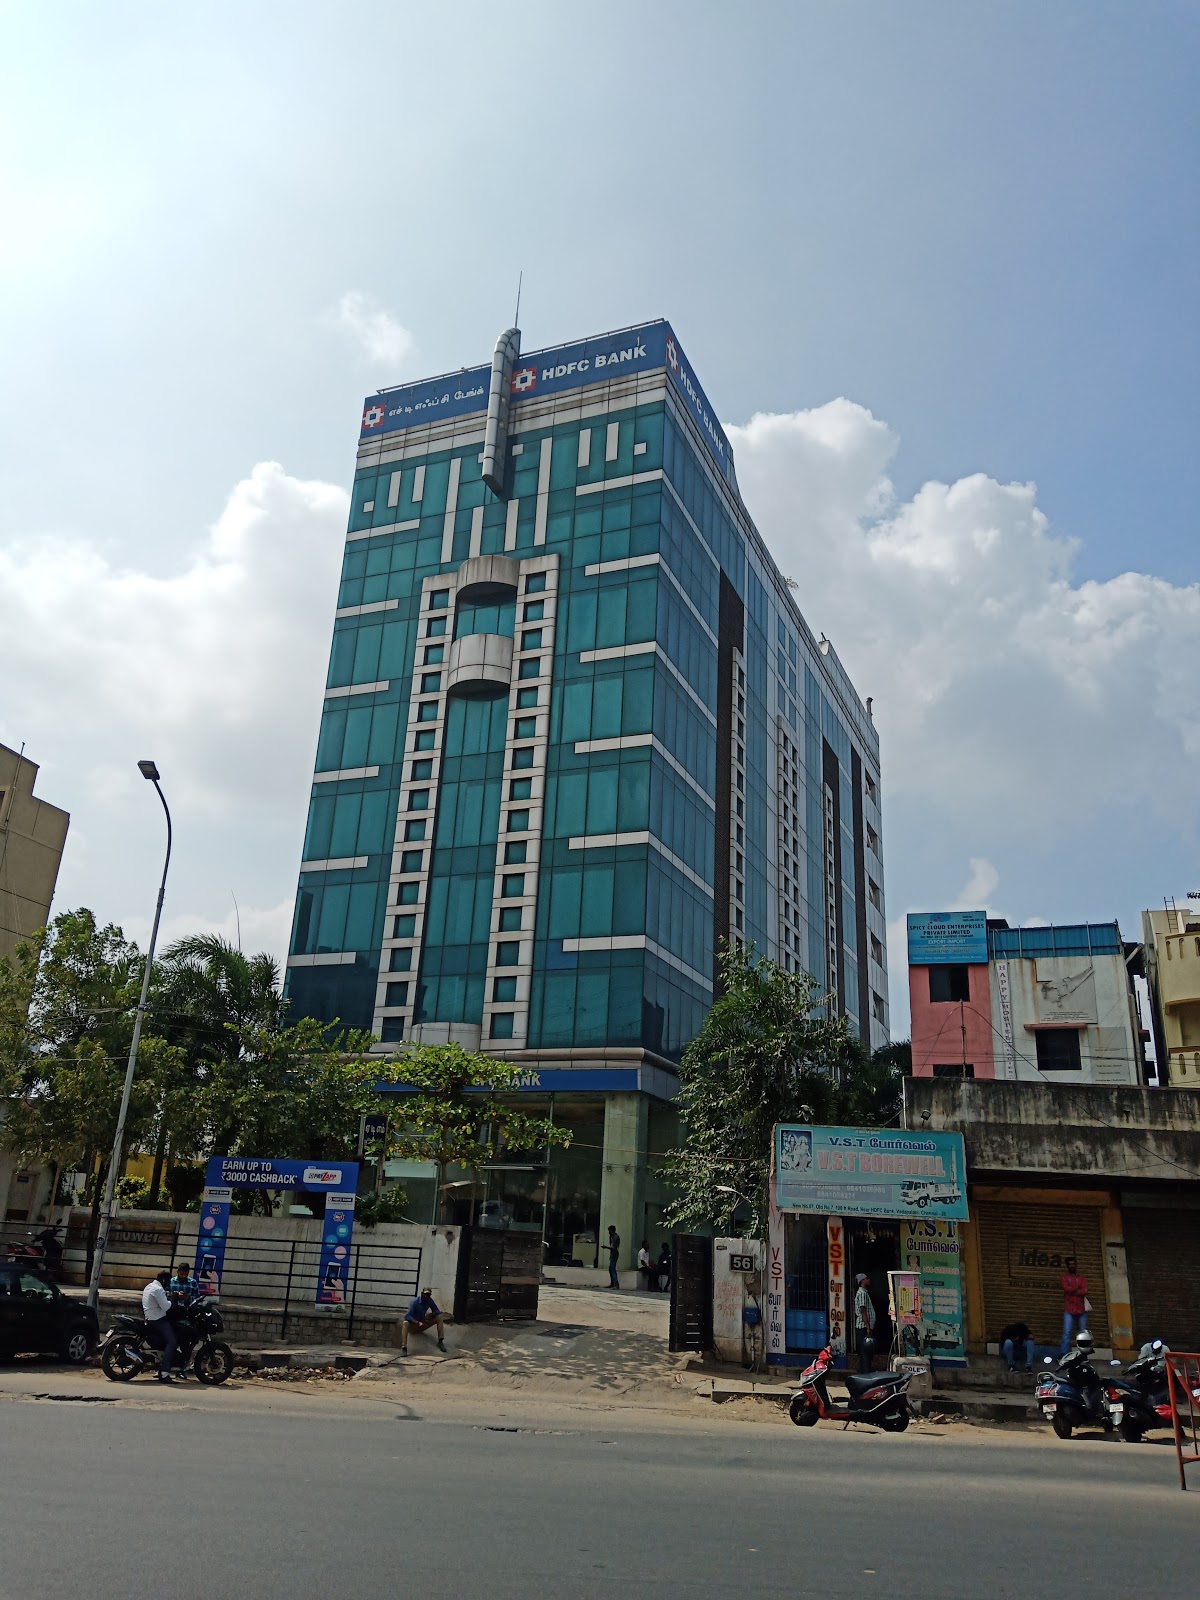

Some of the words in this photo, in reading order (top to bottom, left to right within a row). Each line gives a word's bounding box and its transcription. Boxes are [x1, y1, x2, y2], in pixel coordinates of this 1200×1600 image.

[542, 359, 590, 381] HDFC
[594, 344, 647, 368] BANK
[680, 366, 703, 415] HDFC
[703, 410, 724, 458] BANK
[999, 965, 1007, 1000] HAPPY
[1002, 1004, 1011, 1040] HOSTEL
[828, 1136, 866, 1148] V.S.T
[869, 1137, 937, 1151] போர்வெல்
[222, 1160, 245, 1170] EARN
[246, 1161, 259, 1171] UP
[260, 1162, 272, 1172] TO
[817, 1150, 857, 1172] V.S.T
[859, 1153, 946, 1177] BOREWELL
[221, 1171, 247, 1182] ₹3000
[906, 1238, 959, 1253] போர்வெல்
[733, 1257, 750, 1269] 56
